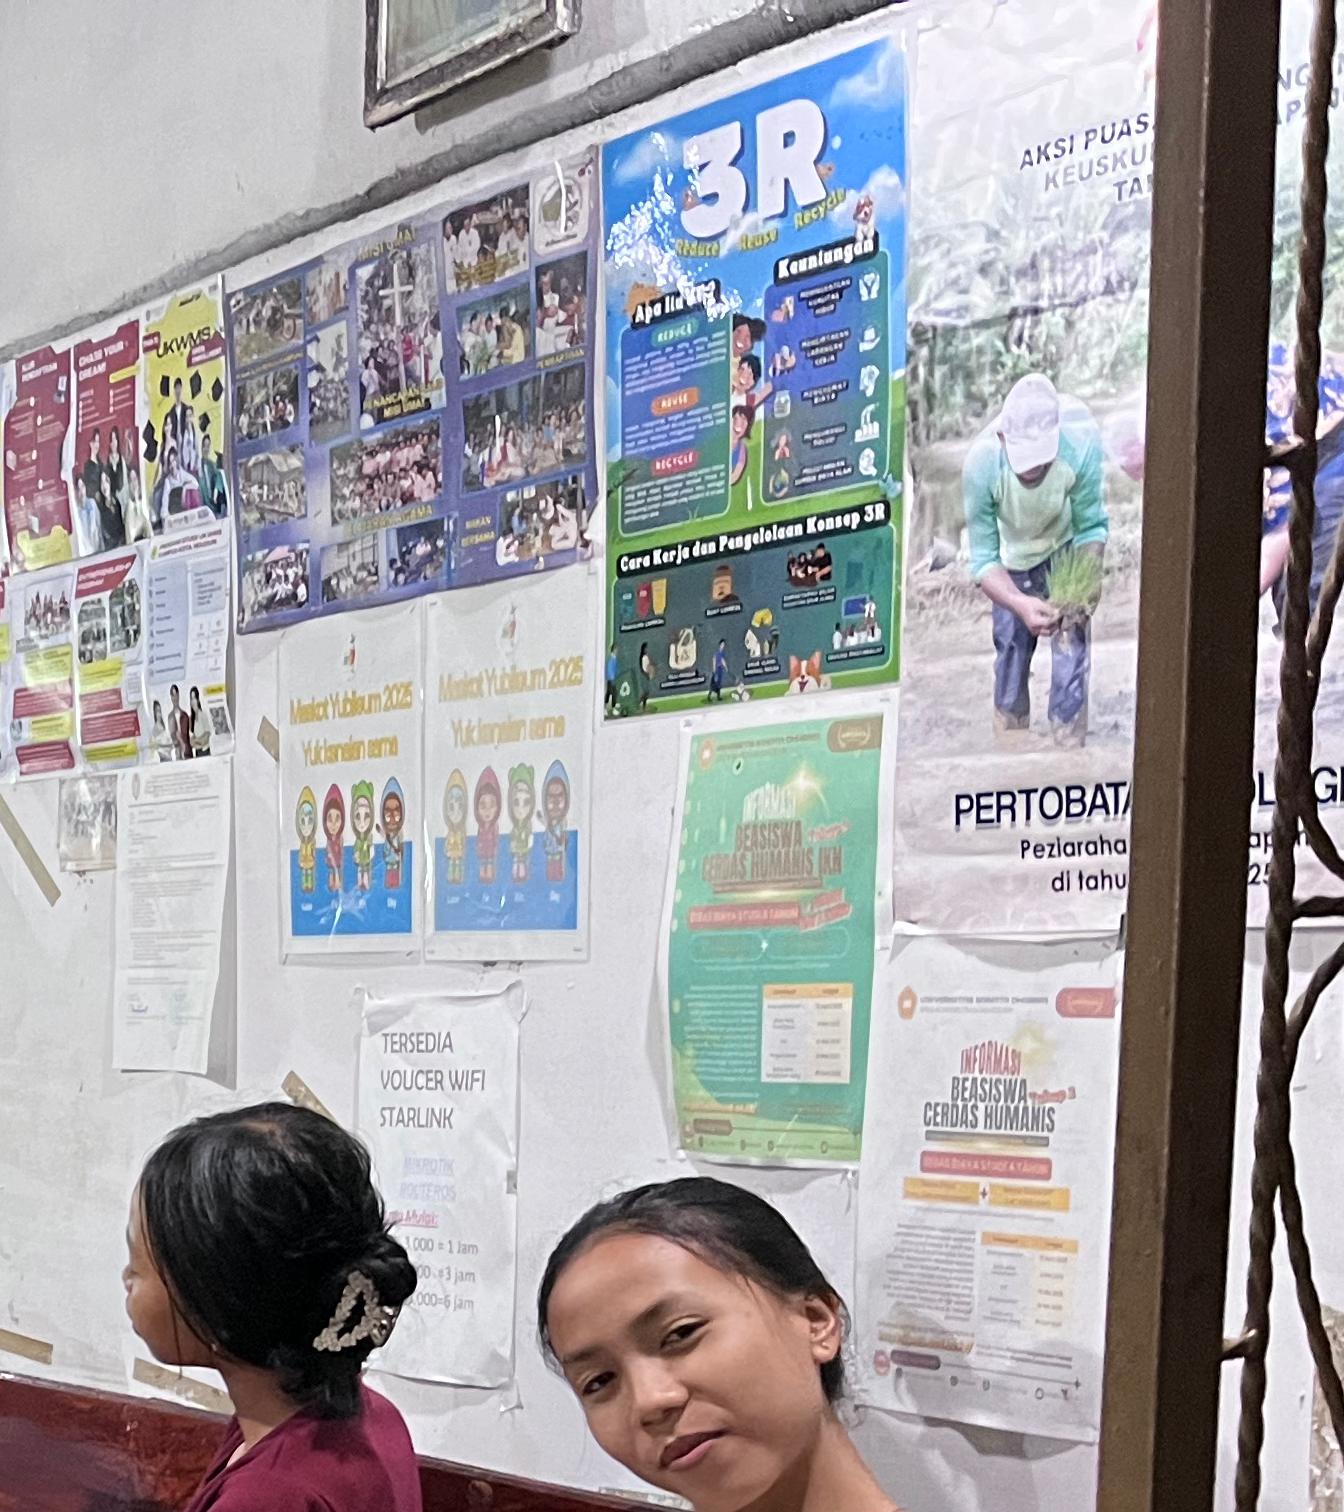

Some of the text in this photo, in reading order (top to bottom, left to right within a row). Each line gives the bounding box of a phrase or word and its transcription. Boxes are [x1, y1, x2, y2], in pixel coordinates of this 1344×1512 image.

[1019, 112, 1155, 170] AKSI PUAS
[680, 98, 827, 239] 3R
[1044, 143, 1154, 192] KEUSKU
[635, 301, 662, 324] Apa
[157, 326, 210, 358] UKWMS
[620, 503, 885, 572] Cara Kerja dan Pengelolaan Konsep 3R
[548, 655, 584, 690] 2025
[383, 680, 413, 713] 2025
[1020, 836, 1127, 860] Peziaraha
[1051, 870, 1127, 891] di tahu
[382, 1031, 454, 1053] TERSEDIA
[960, 1040, 1021, 1076] INFORMASI
[381, 1069, 486, 1091] VOUCER WIFI
[951, 1076, 1028, 1104] BEASISWA
[380, 1107, 454, 1129] STARLINK
[923, 1101, 1056, 1133] CERDAS HUMANIS
[448, 1239, 453, 1254] 1
[454, 1269, 476, 1286] jam
[453, 1297, 474, 1312] jam
